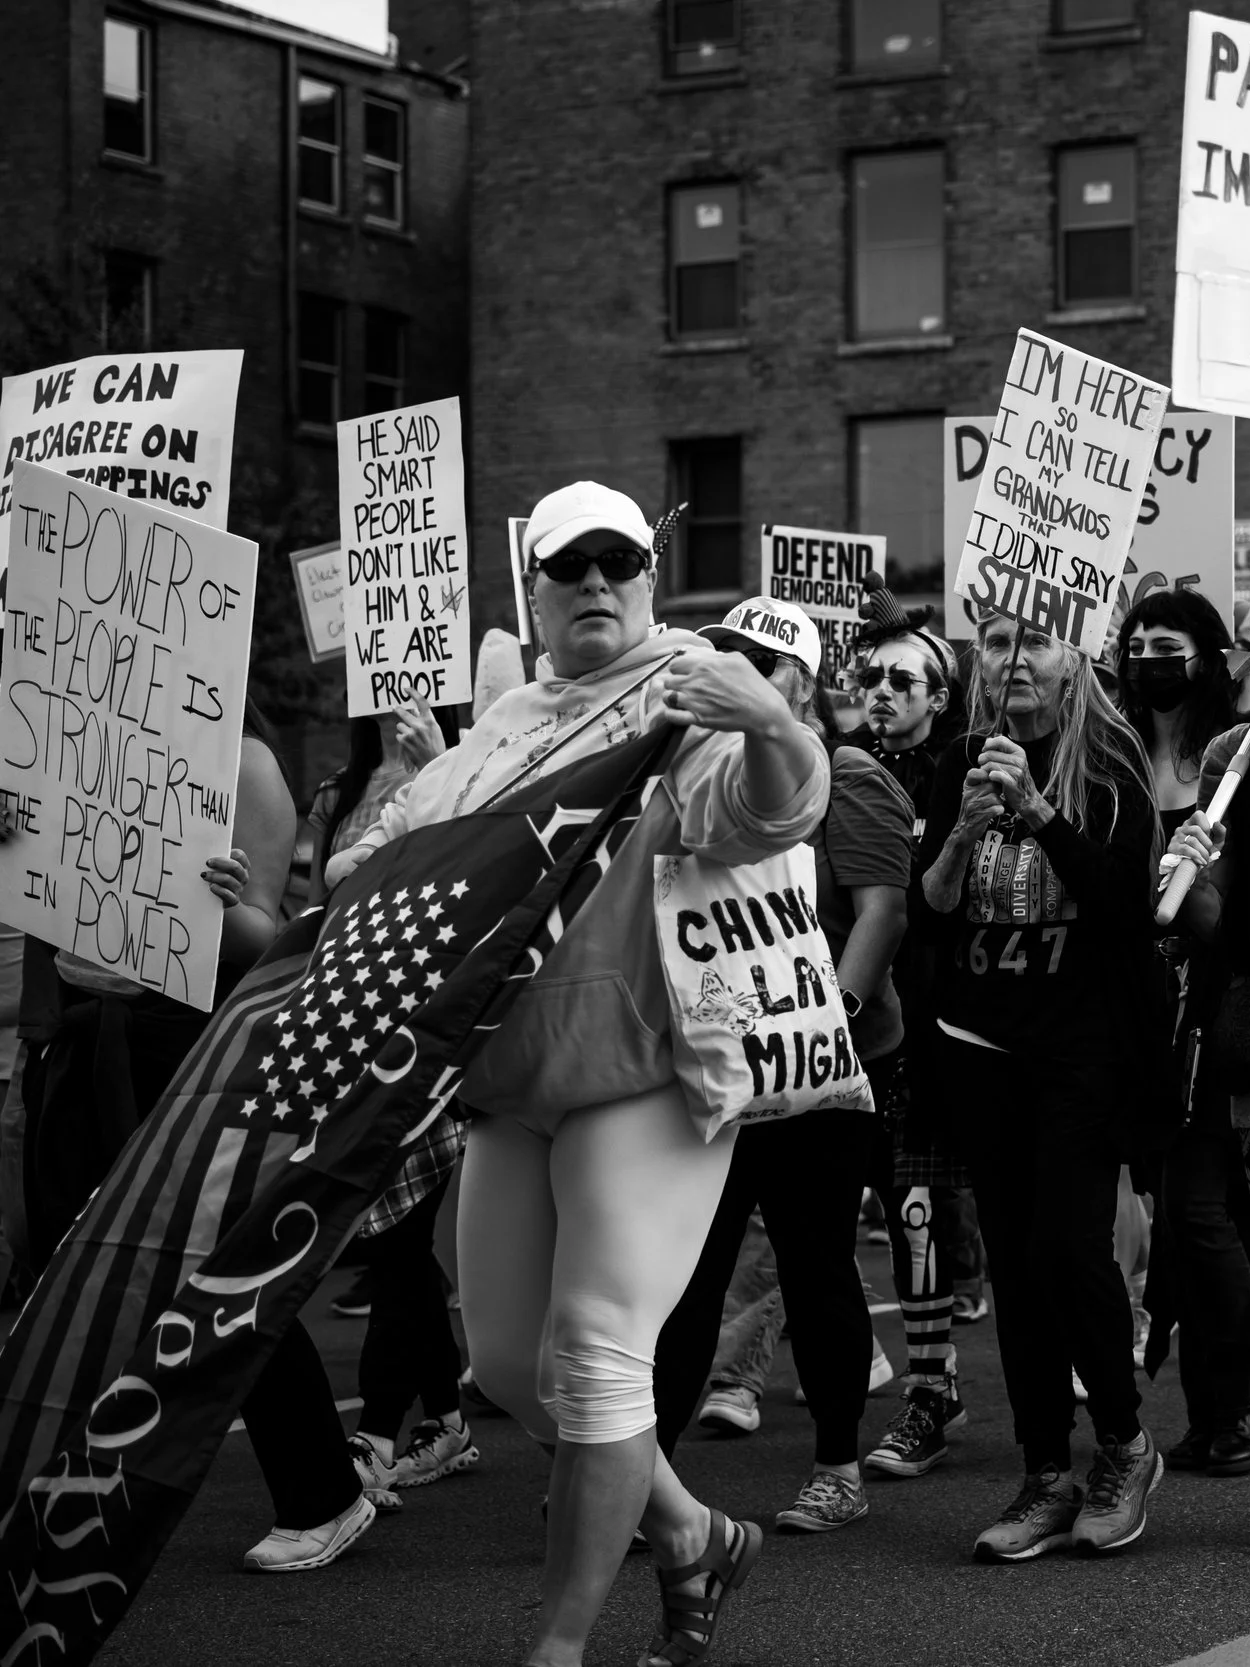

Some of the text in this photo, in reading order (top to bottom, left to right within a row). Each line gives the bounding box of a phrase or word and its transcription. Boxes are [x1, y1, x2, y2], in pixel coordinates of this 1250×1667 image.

[32, 363, 179, 414] WE CAN
[1075, 361, 1161, 431] HERE
[357, 415, 440, 462] HE SAID
[1054, 407, 1078, 433] SO
[3, 421, 198, 478] DISAGREE ON
[992, 406, 1019, 447] I
[1025, 420, 1074, 472] CAN
[1083, 441, 1133, 492] TELL
[363, 456, 435, 500] SMART
[994, 466, 1111, 540] GRANDKIDS
[1039, 465, 1064, 489] MY
[354, 497, 437, 543] PEOPLE
[1018, 511, 1057, 538] THAT
[19, 504, 57, 554] THE
[60, 491, 193, 646] POWER
[199, 580, 240, 621] OF
[348, 536, 459, 586] DON'T LIKE
[772, 535, 873, 584] DEFEND
[967, 510, 998, 551] I
[1062, 556, 1116, 603] STAY
[365, 584, 409, 625] HIM
[418, 584, 435, 622] &
[770, 576, 864, 609] DEMOCRACY
[967, 556, 1098, 647] SILENT
[355, 629, 389, 666] WE
[403, 624, 452, 663] ARE
[740, 608, 800, 646] KINGS
[843, 621, 862, 644] FO
[8, 609, 47, 655] THE
[51, 597, 172, 736] PEOPLE
[182, 674, 223, 721] IS
[371, 669, 446, 709] PROOF
[4, 679, 229, 838] STRONGER THAN
[0, 788, 182, 908] THE PEOPLE
[981, 832, 999, 921] KINDNESS
[1013, 844, 1034, 917] DIVERSITY
[1031, 853, 1042, 910] NITY
[24, 870, 190, 1002] IN POWER
[750, 956, 827, 1015] LA
